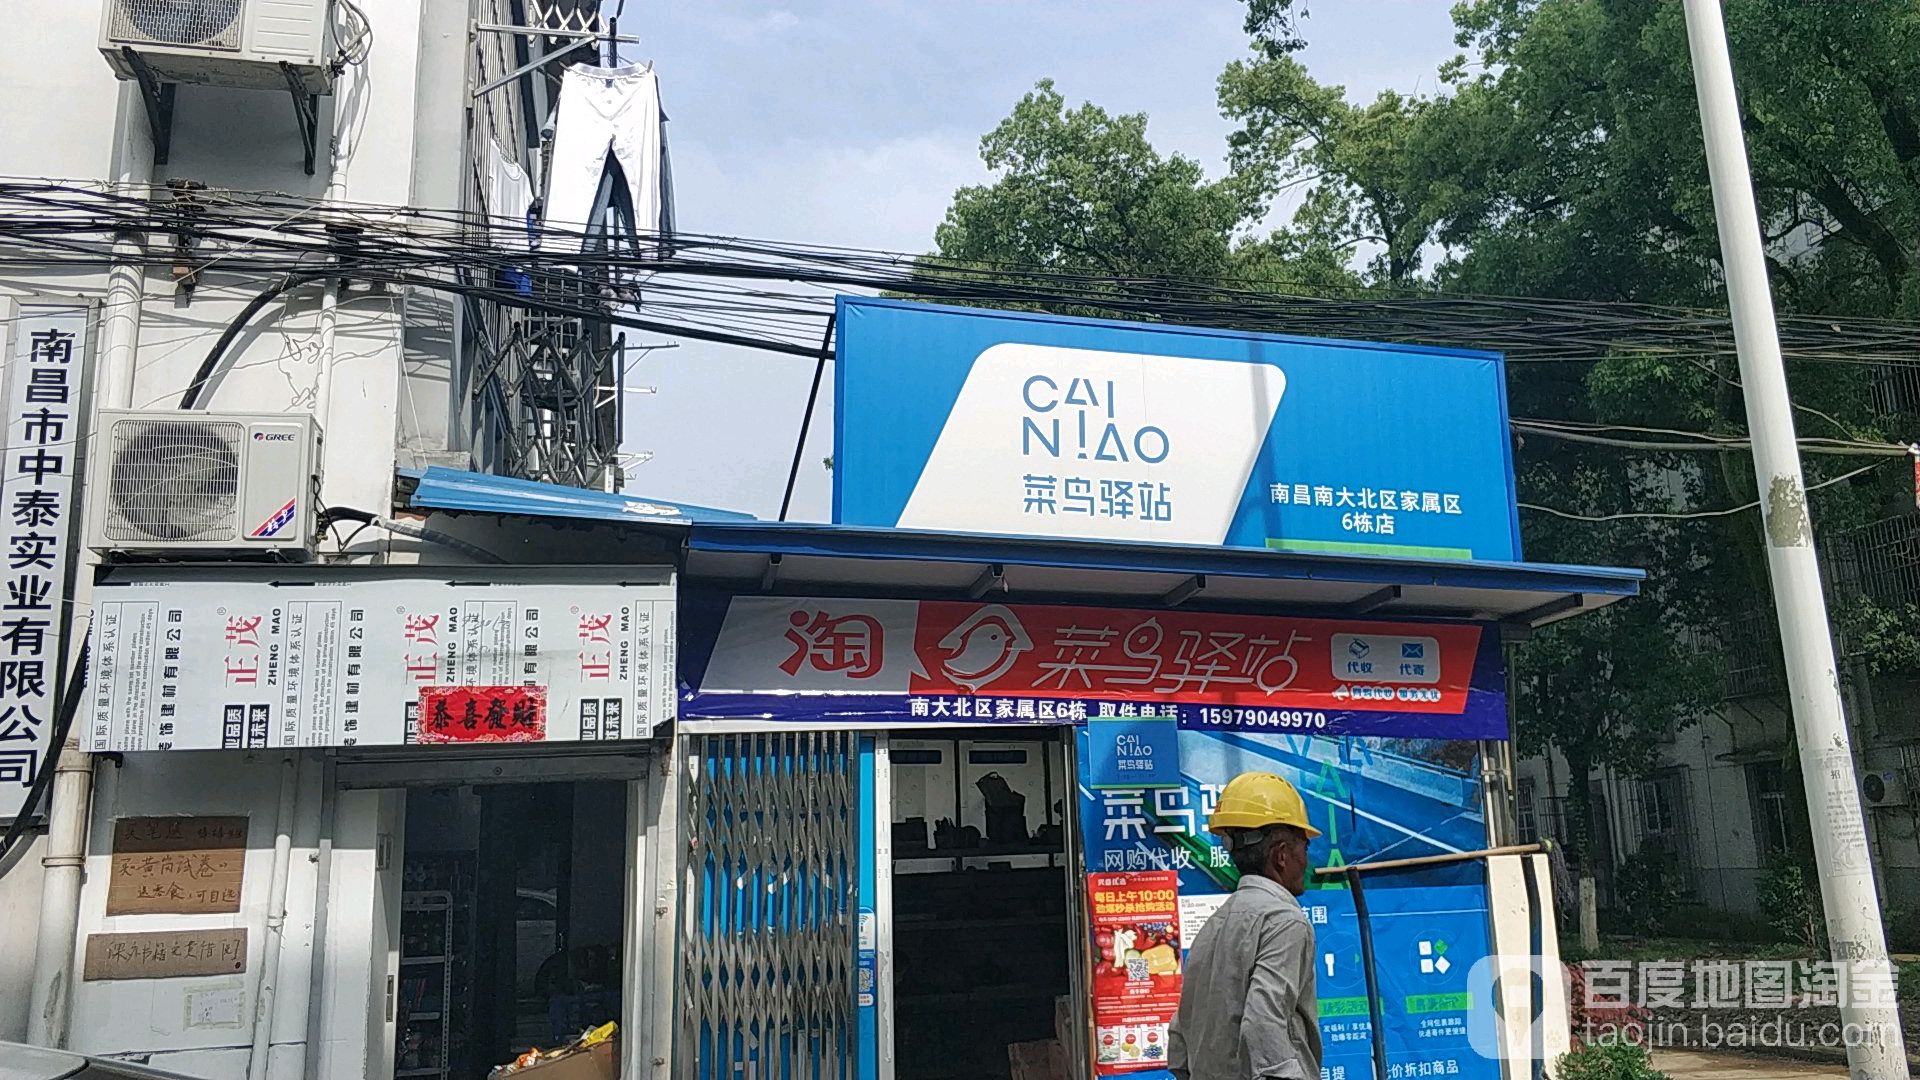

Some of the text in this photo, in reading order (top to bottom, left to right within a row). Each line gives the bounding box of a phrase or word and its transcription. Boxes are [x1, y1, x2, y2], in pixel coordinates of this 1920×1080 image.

[1022, 374, 1114, 419] CAI
[265, 433, 295, 442] GREE
[1023, 474, 1172, 522] 菜鸟驿站
[1270, 483, 1463, 516] 南昌南大北区家属区
[1342, 512, 1395, 537] 6栋店
[0, 329, 76, 788] 南昌市中泰实业有限公司
[224, 615, 263, 688] 正茂
[267, 608, 281, 686] ZHENG MAO
[404, 613, 441, 685] 正茂
[446, 607, 458, 683] ZHENG MAO
[578, 613, 613, 683] 正茂
[619, 606, 630, 681] ZHENG MAO
[778, 609, 885, 681] 淘
[1031, 616, 1313, 697] 菜鸟驿站
[284, 612, 304, 746] 国际质量环境体系认证
[637, 611, 650, 737] 国际质量环境体系认证
[1347, 661, 1373, 674] 代收
[1399, 663, 1425, 676] 代寄
[911, 697, 1087, 719] 南大北区家属区6栋
[1200, 707, 1326, 728] 15979049970
[1116, 735, 1139, 744] CAI
[1117, 759, 1154, 771] 菜鸟驿站
[1104, 846, 1237, 872] 网购代收·服
[1094, 890, 1175, 903] 每日上午10:00
[1095, 901, 1175, 914] 劲爆秒杀抢购活动
